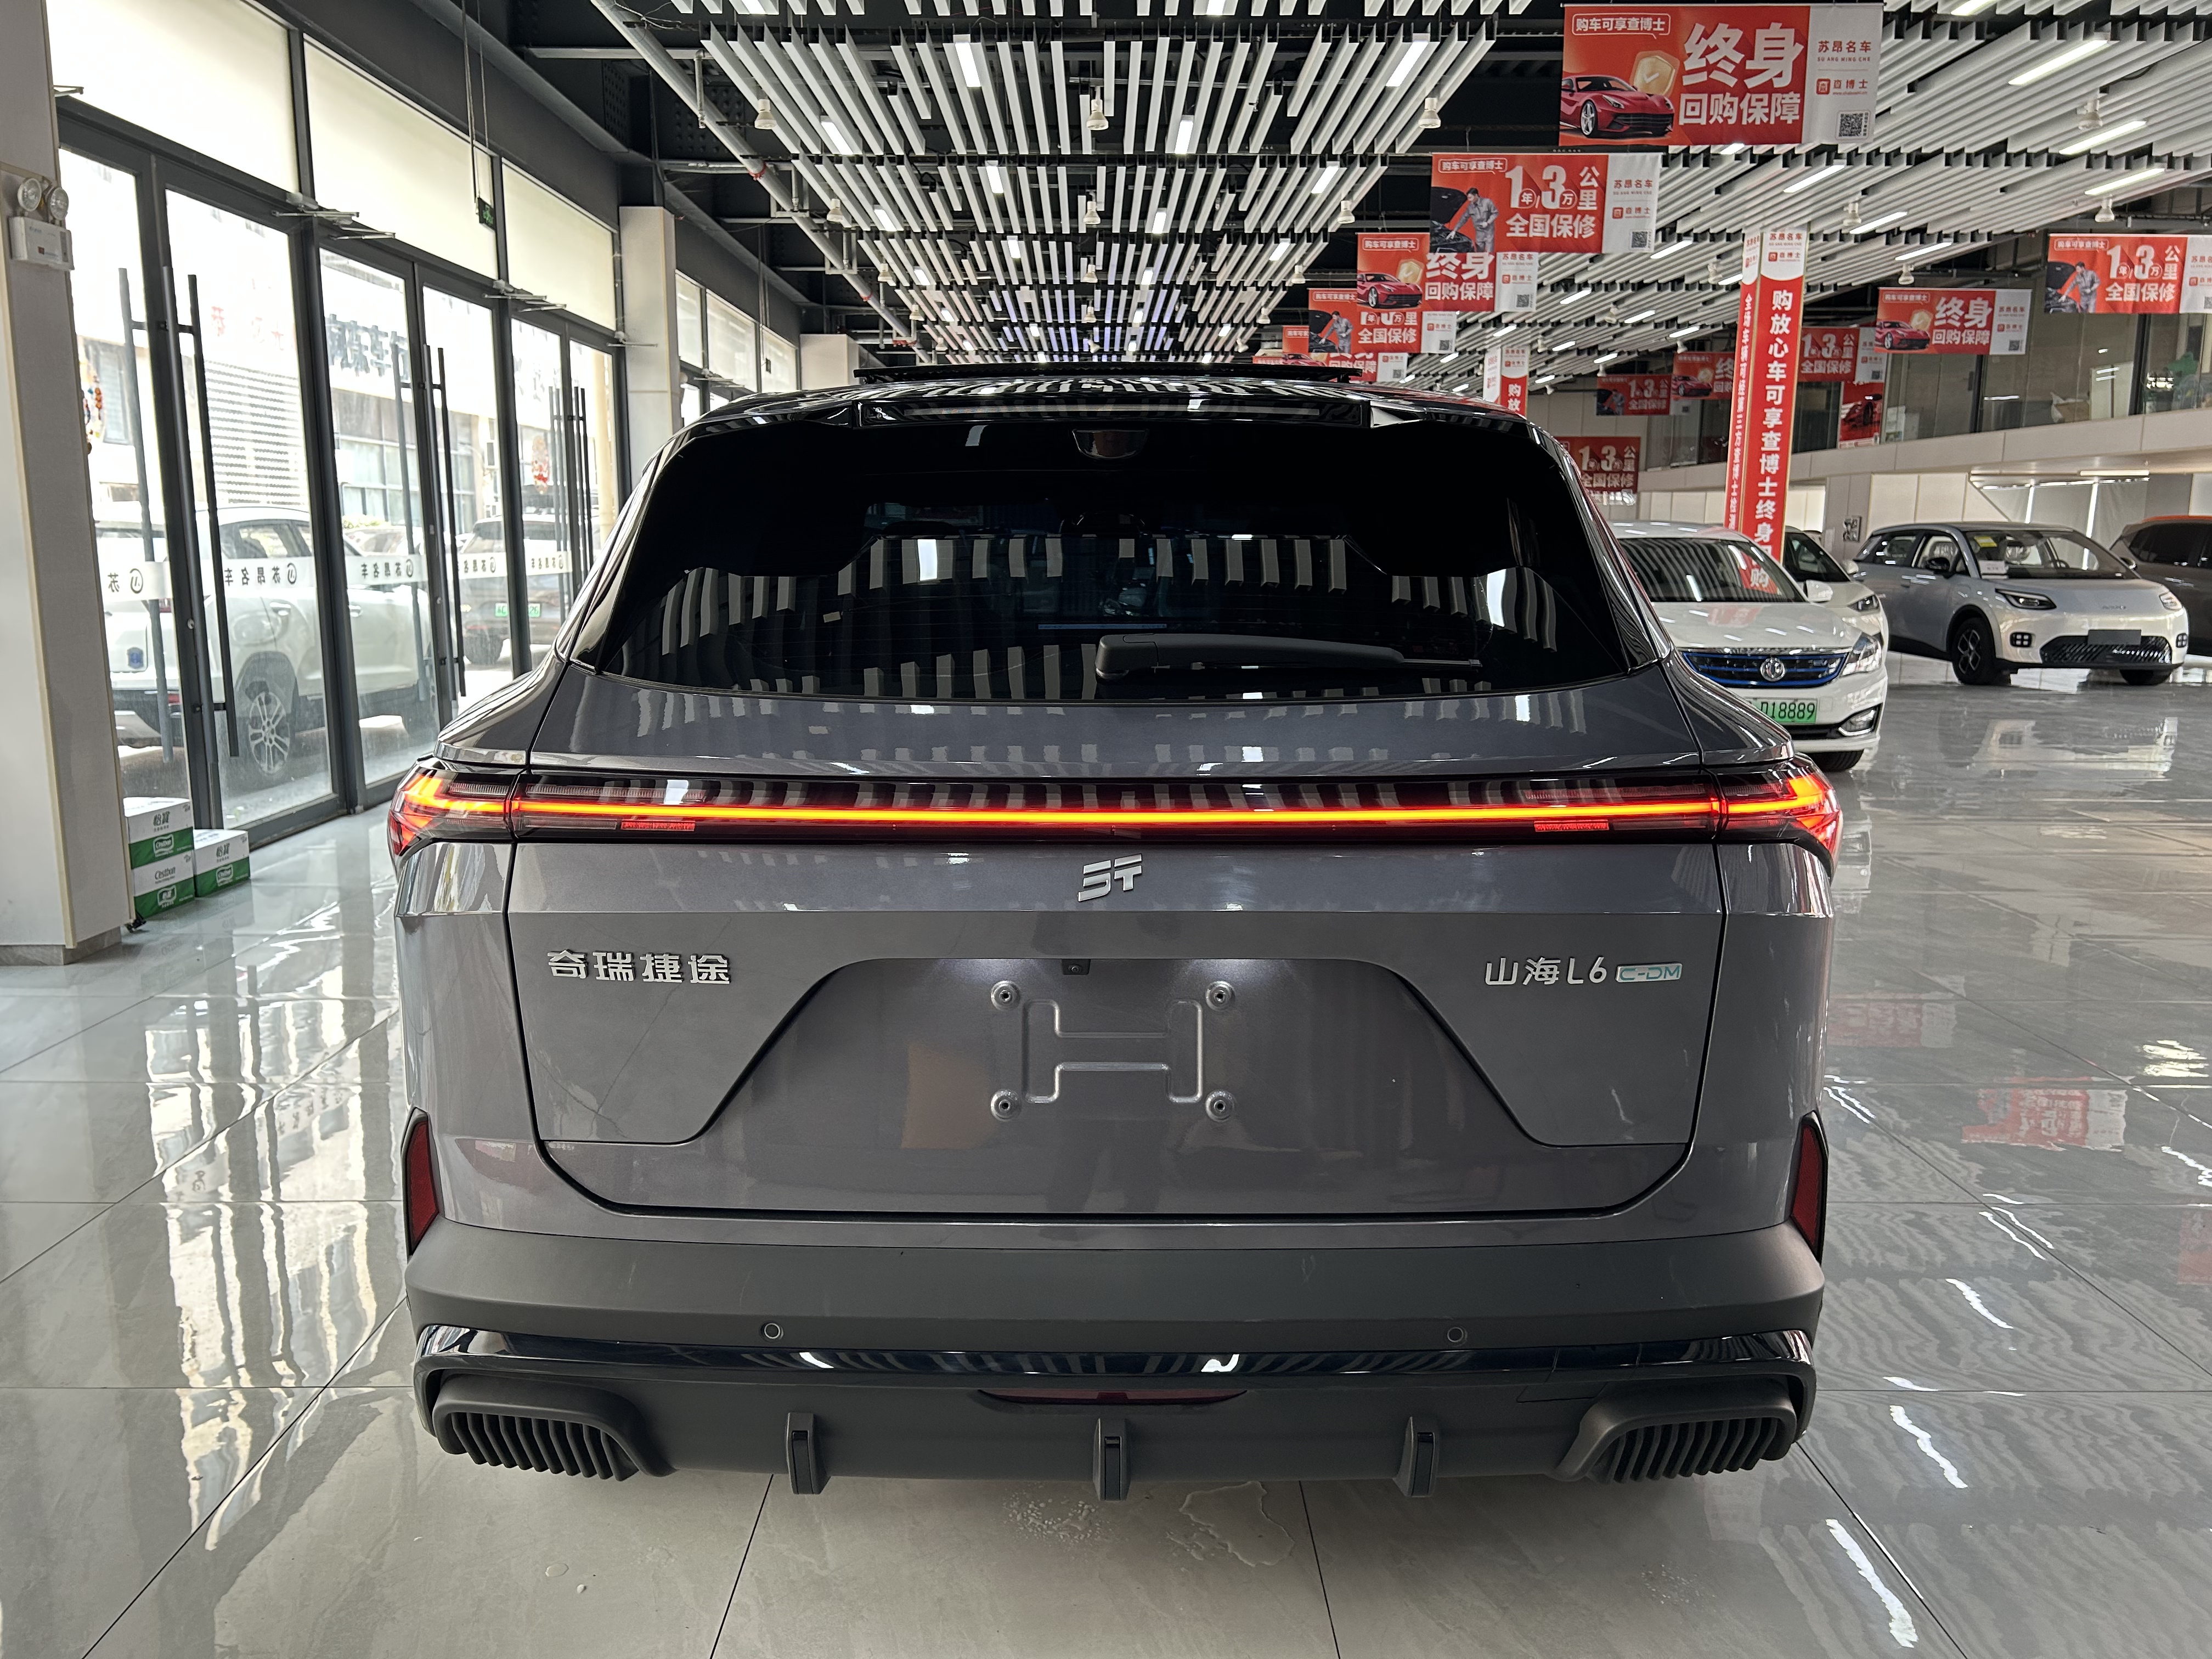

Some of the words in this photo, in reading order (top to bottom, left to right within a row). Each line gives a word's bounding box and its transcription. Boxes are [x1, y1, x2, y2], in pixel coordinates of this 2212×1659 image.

[1576, 17, 1666, 32] 购车可享查博士
[1682, 22, 1804, 88] 终身
[1818, 40, 1872, 53] 苏昂名车
[1833, 78, 1868, 89] 查博士
[1679, 91, 1801, 126] 回购保障
[1506, 213, 1596, 239] 全国保修
[1426, 252, 1495, 280] 终身
[1425, 281, 1494, 301] 回购保障
[2105, 281, 2176, 302] 全国保修
[1934, 296, 1993, 329] 终身
[1358, 328, 1417, 344] 全国保修
[1932, 329, 1991, 346] 回购保障
[1801, 360, 1852, 374] 全国保修
[1581, 473, 1634, 488] 全国保修
[548, 949, 731, 985] 奇瑞捷途
[1619, 966, 1681, 981] C-DM
